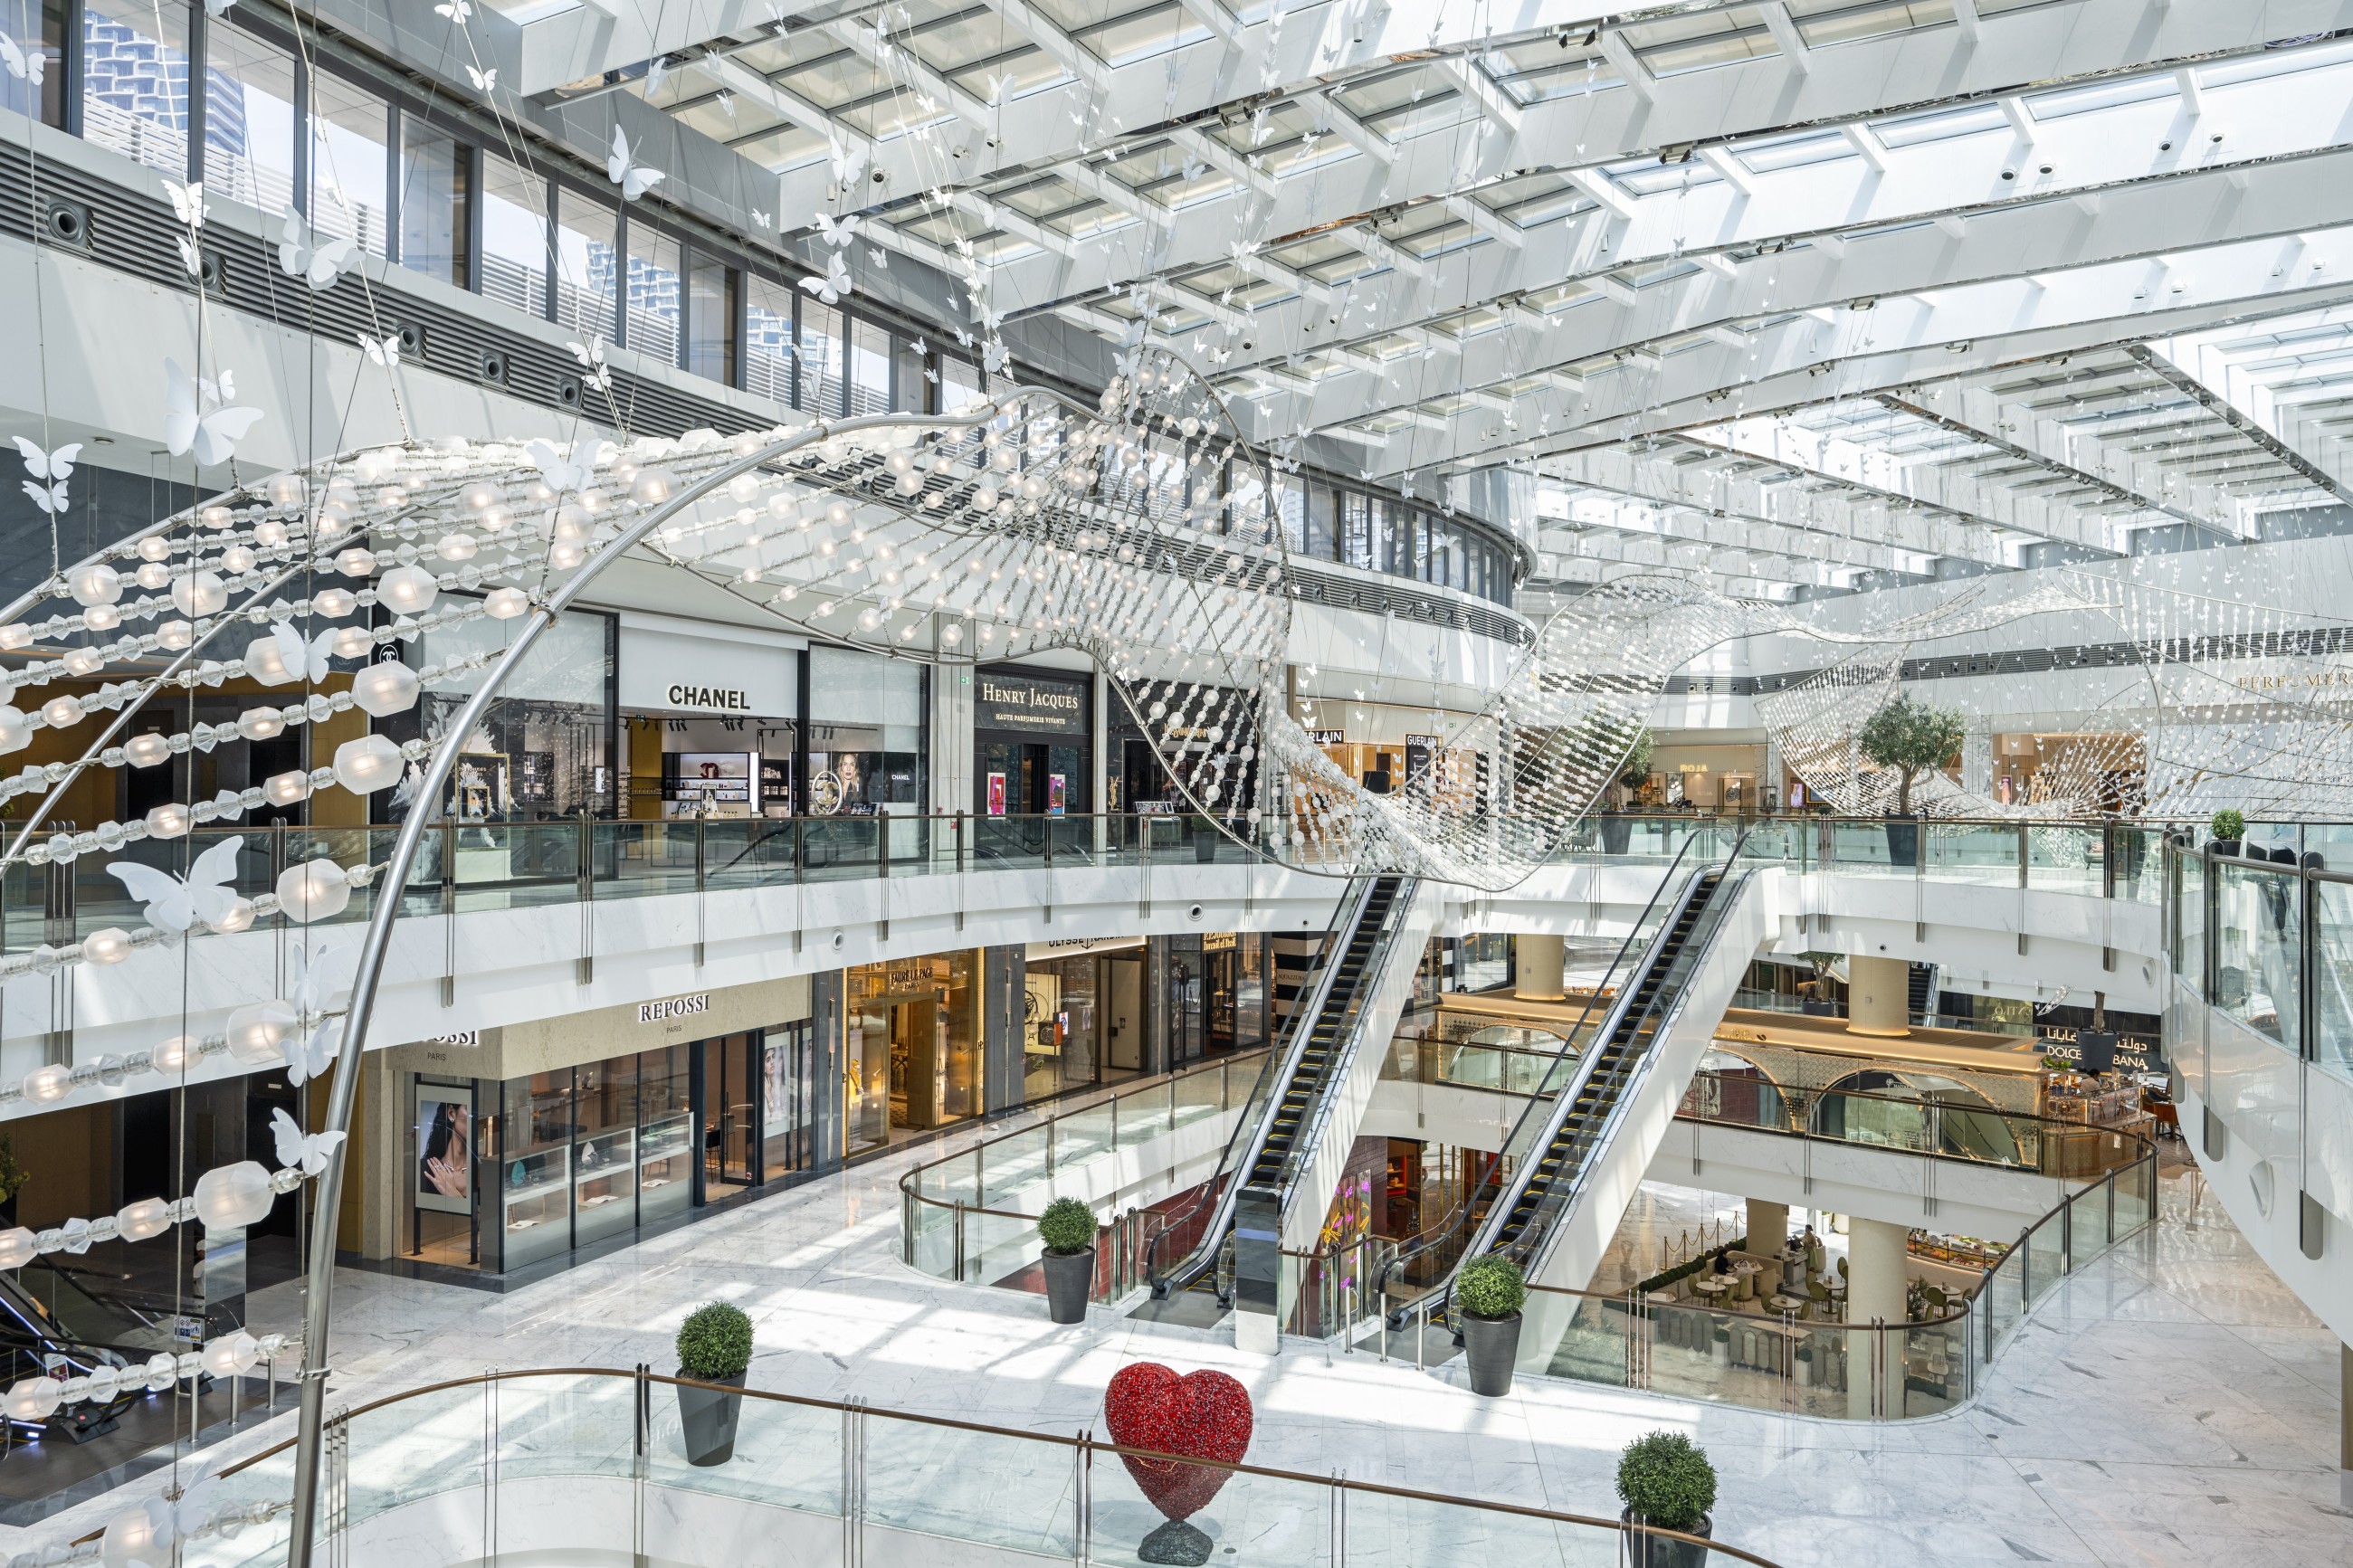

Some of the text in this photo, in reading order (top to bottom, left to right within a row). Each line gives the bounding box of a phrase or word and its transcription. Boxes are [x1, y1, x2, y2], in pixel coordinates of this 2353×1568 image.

[2238, 672, 2352, 689] PERFUMER
[668, 685, 750, 710] CHANEL
[983, 683, 1078, 709] HENRY JACQUES
[996, 713, 1066, 725] HAUTE PARFUMERIE VIVANTE
[1306, 731, 1343, 743] RLAIN
[1407, 735, 1437, 747] GUERLAN
[1680, 764, 1709, 773] ROJA
[640, 994, 710, 1022] REPOSSI
[666, 1024, 682, 1034] PARIS
[2116, 1037, 2148, 1054] دولت
[427, 1051, 447, 1061] PARIS
[2047, 1045, 2147, 1068] DOLCE BANA
